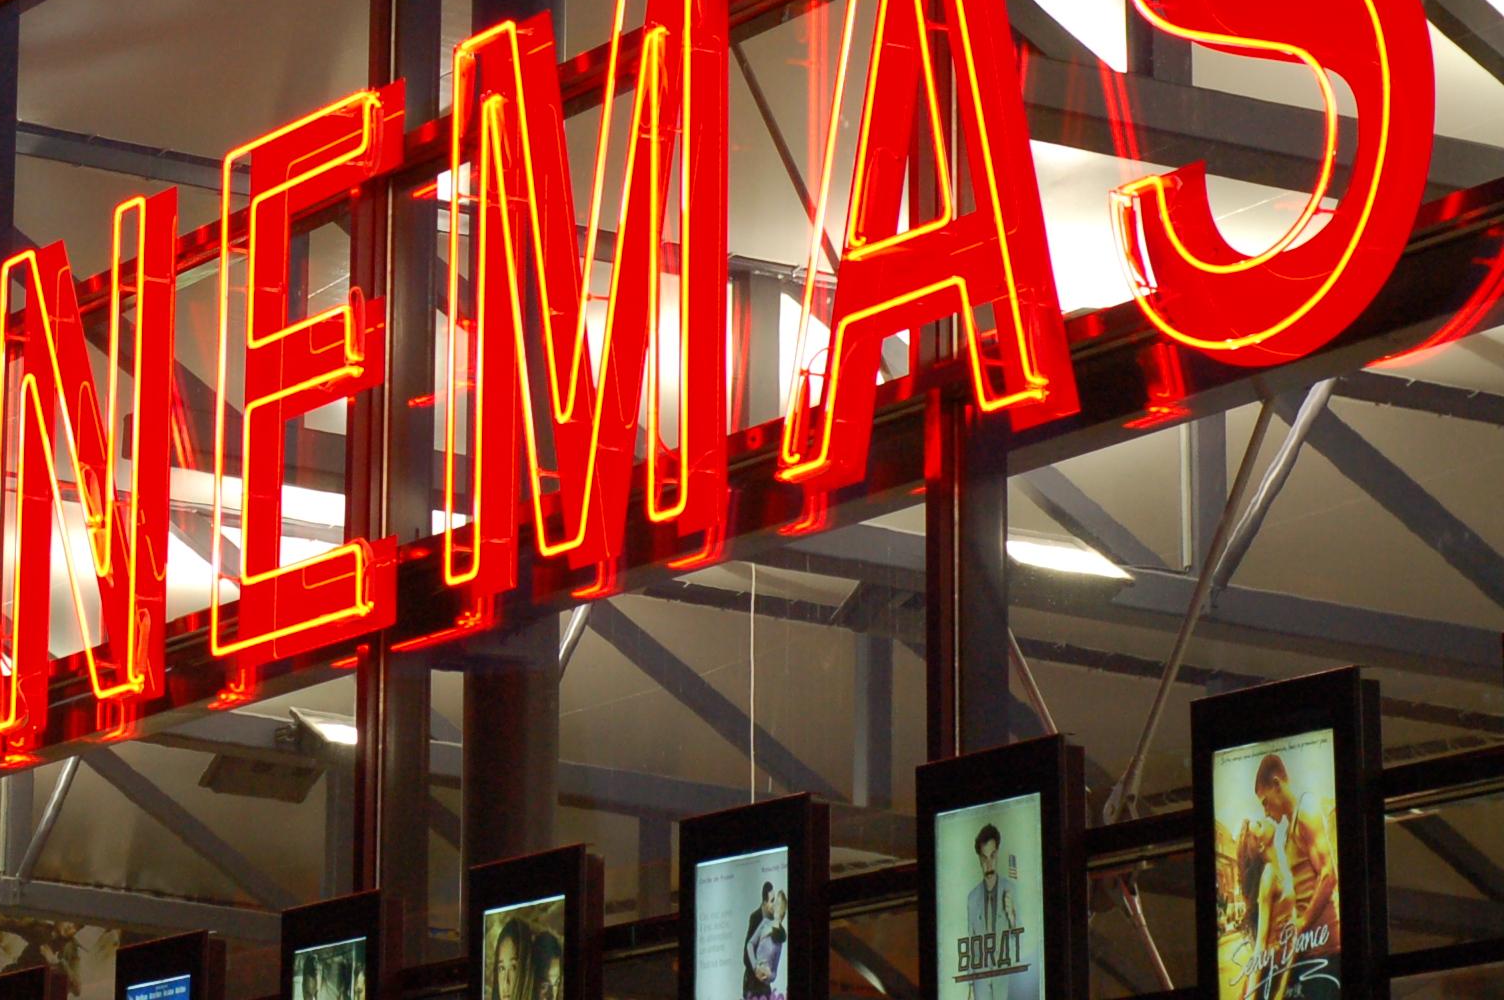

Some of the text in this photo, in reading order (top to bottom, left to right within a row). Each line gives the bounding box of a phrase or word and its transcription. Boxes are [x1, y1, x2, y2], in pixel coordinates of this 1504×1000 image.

[957, 927, 1025, 972] BORAT
[1229, 921, 1330, 1000] Sexy Dance
